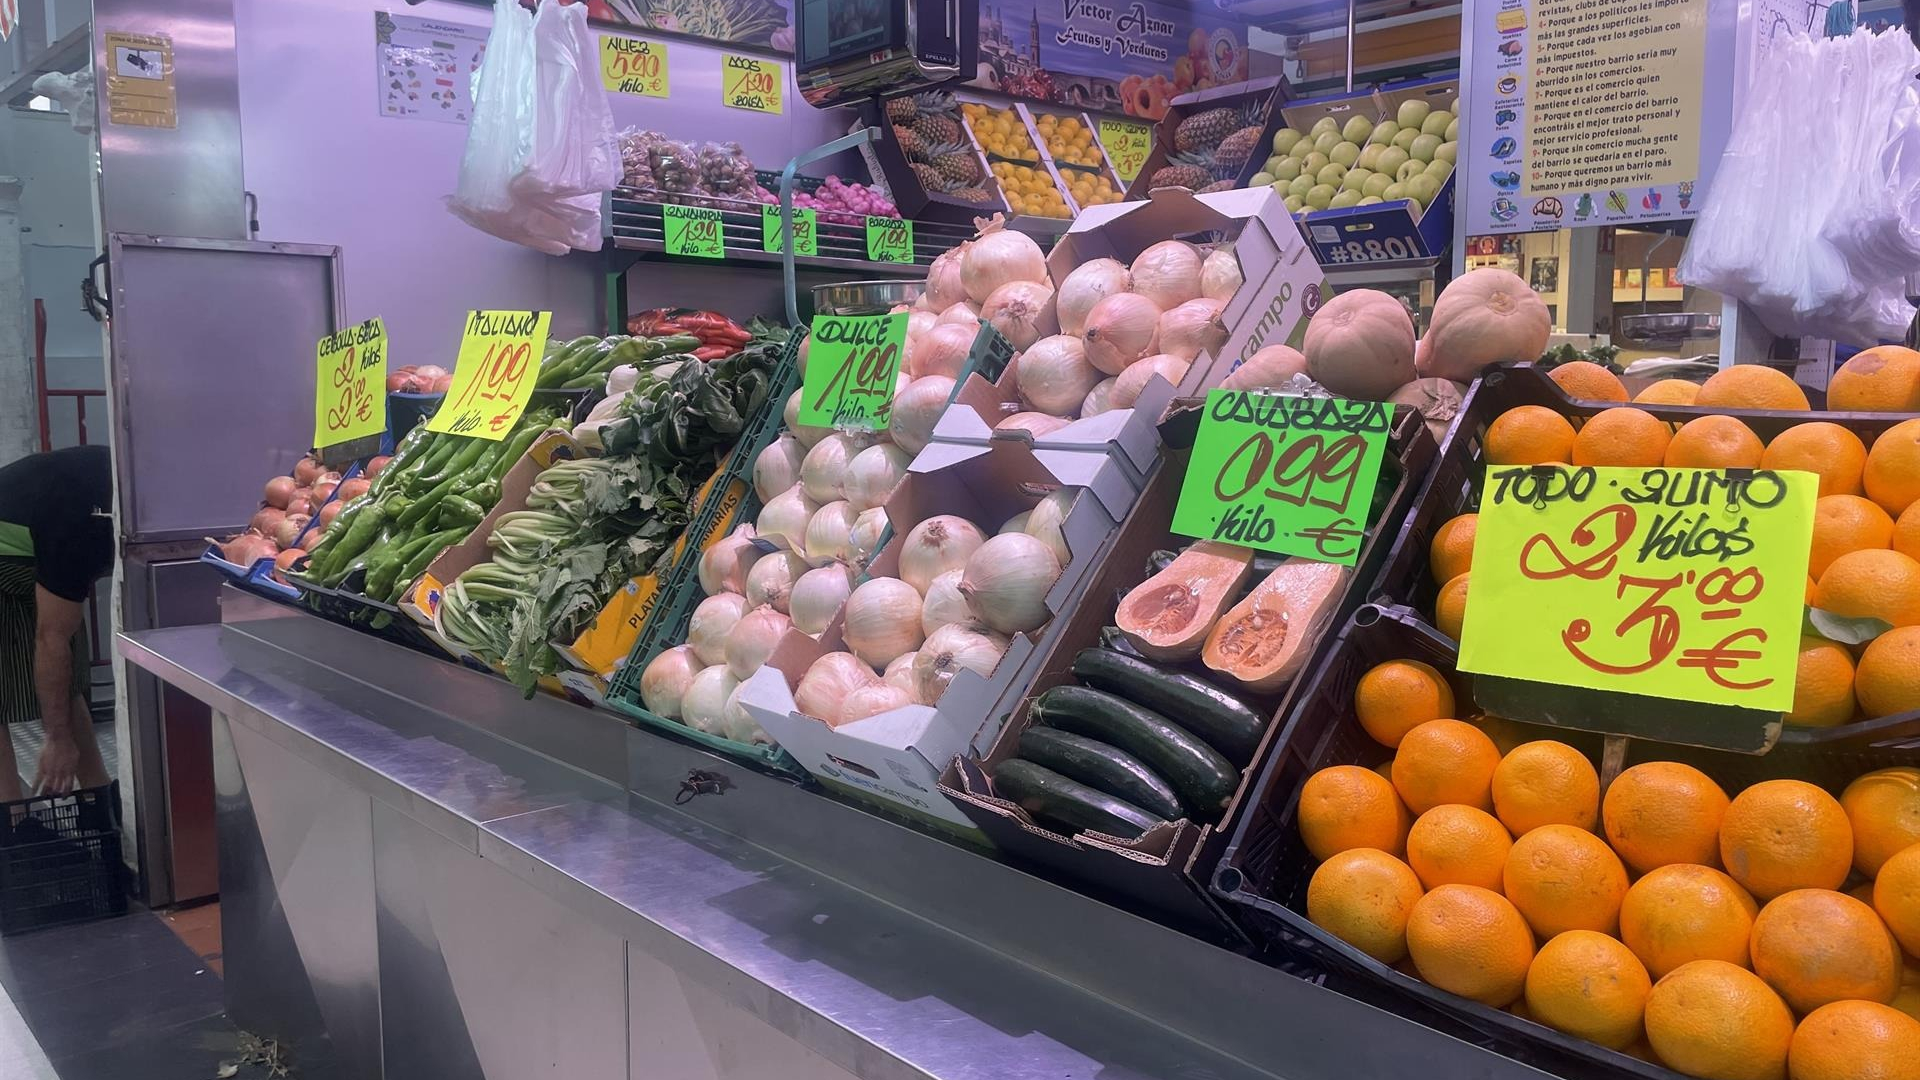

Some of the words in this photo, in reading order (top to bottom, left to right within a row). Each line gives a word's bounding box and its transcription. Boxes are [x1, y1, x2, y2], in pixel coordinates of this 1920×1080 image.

[1548, 17, 1575, 28] Porque
[1585, 12, 1597, 21] los
[1640, 3, 1652, 11] les
[1575, 1, 1596, 11] clubs
[1117, 3, 1174, 34] Aznar
[1537, 30, 1552, 40] más
[1554, 29, 1565, 38] las
[1568, 22, 1599, 37] grandes
[1602, 15, 1651, 30] superficies.
[607, 37, 650, 54] NUEZ
[1057, 27, 1101, 46] Frutas
[1104, 38, 1111, 51] y
[1115, 37, 1167, 59] Verduras
[1547, 40, 1574, 51] Porque
[1577, 36, 1596, 47] cada
[1598, 34, 1612, 42] vez
[1614, 30, 1626, 40] los
[1629, 24, 1663, 38] agobian
[1665, 22, 1681, 31] con
[1536, 68, 1544, 76] 6-
[1546, 64, 1573, 75] Porque
[1576, 60, 1605, 70] nuestro
[1609, 53, 1633, 65] barrio
[1660, 48, 1677, 56] muy
[1537, 53, 1551, 64] más
[1553, 49, 1596, 62] impuestos.
[1536, 77, 1569, 88] aburrido
[1572, 74, 1583, 83] sin
[1585, 71, 1597, 80] los
[1600, 66, 1645, 78] comercios.
[1545, 88, 1572, 99] Porque
[1586, 83, 1594, 92] el
[1596, 79, 1634, 91] comercio
[1637, 75, 1660, 86] quien
[1534, 100, 1570, 111] mantiene
[1572, 98, 1579, 106] el
[1582, 94, 1602, 104] calor
[1604, 91, 1617, 100] del
[1620, 89, 1648, 98] barrio.
[1543, 111, 1571, 122] Porque
[1585, 106, 1592, 115] el
[1595, 103, 1633, 114] comercio
[1635, 99, 1649, 109] del
[1652, 97, 1678, 107] barrio
[1102, 122, 1121, 132] TODO
[1534, 123, 1575, 134] encontráis
[1577, 119, 1584, 128] el
[1586, 118, 1609, 130] mejor
[1613, 113, 1633, 124] trato
[1636, 110, 1673, 124] personal
[1675, 109, 1680, 118] y
[1533, 136, 1555, 147] mejor
[1558, 132, 1589, 143] servicio
[1592, 126, 1642, 140] profesional.
[1533, 149, 1540, 157] 9-
[1542, 146, 1569, 157] Porque
[1572, 143, 1583, 152] sin
[1585, 138, 1623, 151] comercio
[1625, 135, 1651, 146] mucha
[1653, 133, 1678, 145] gente
[1532, 160, 1544, 169] del
[1547, 155, 1570, 167] barrio
[1623, 151, 1632, 159] en
[1635, 149, 1643, 157] el
[1645, 147, 1667, 157] paro.
[1545, 168, 1572, 180] Porque
[1574, 165, 1613, 177] queremos
[1627, 160, 1653, 170] barrio
[1655, 158, 1671, 167] más
[1531, 182, 1559, 192] humano
[1562, 182, 1567, 191] y
[1568, 178, 1583, 188] más
[1586, 175, 1609, 187] digno
[1611, 176, 1629, 186] para
[1632, 172, 1652, 182] vivir.
[468, 314, 538, 338] ITALIANO
[816, 317, 893, 346] DULCE
[1492, 466, 1597, 506] TODO
[1620, 468, 1788, 509] ZUMO
[1295, 518, 1363, 558] €
[1519, 503, 1638, 580] 2
[1676, 627, 1775, 690] €
